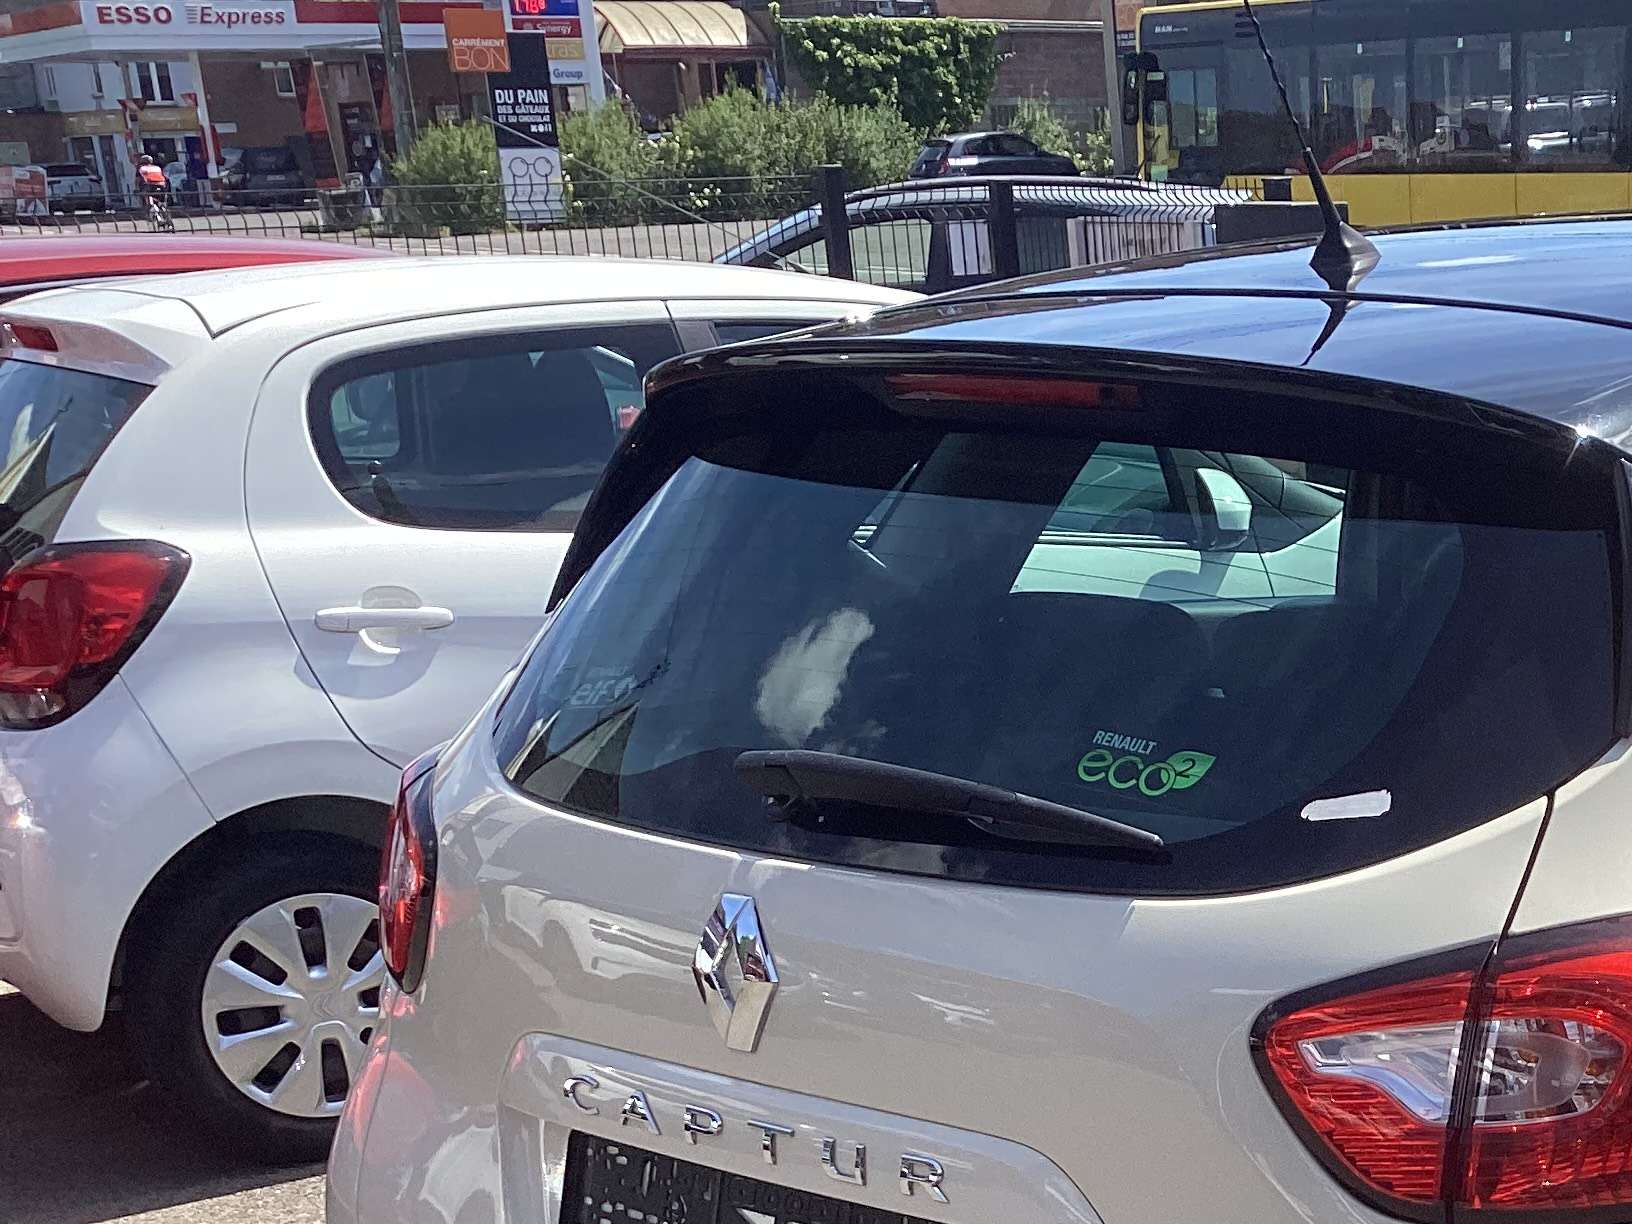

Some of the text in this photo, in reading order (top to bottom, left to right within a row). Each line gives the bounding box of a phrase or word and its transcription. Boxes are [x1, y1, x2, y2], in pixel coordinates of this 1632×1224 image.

[96, 5, 286, 29] ESSO Express
[453, 46, 511, 71] BON
[552, 68, 583, 80] Group
[494, 89, 549, 104] DU PAIN
[497, 105, 513, 114] DES
[1093, 730, 1157, 755] RENAULT
[563, 1073, 950, 1204] CAPTUR
